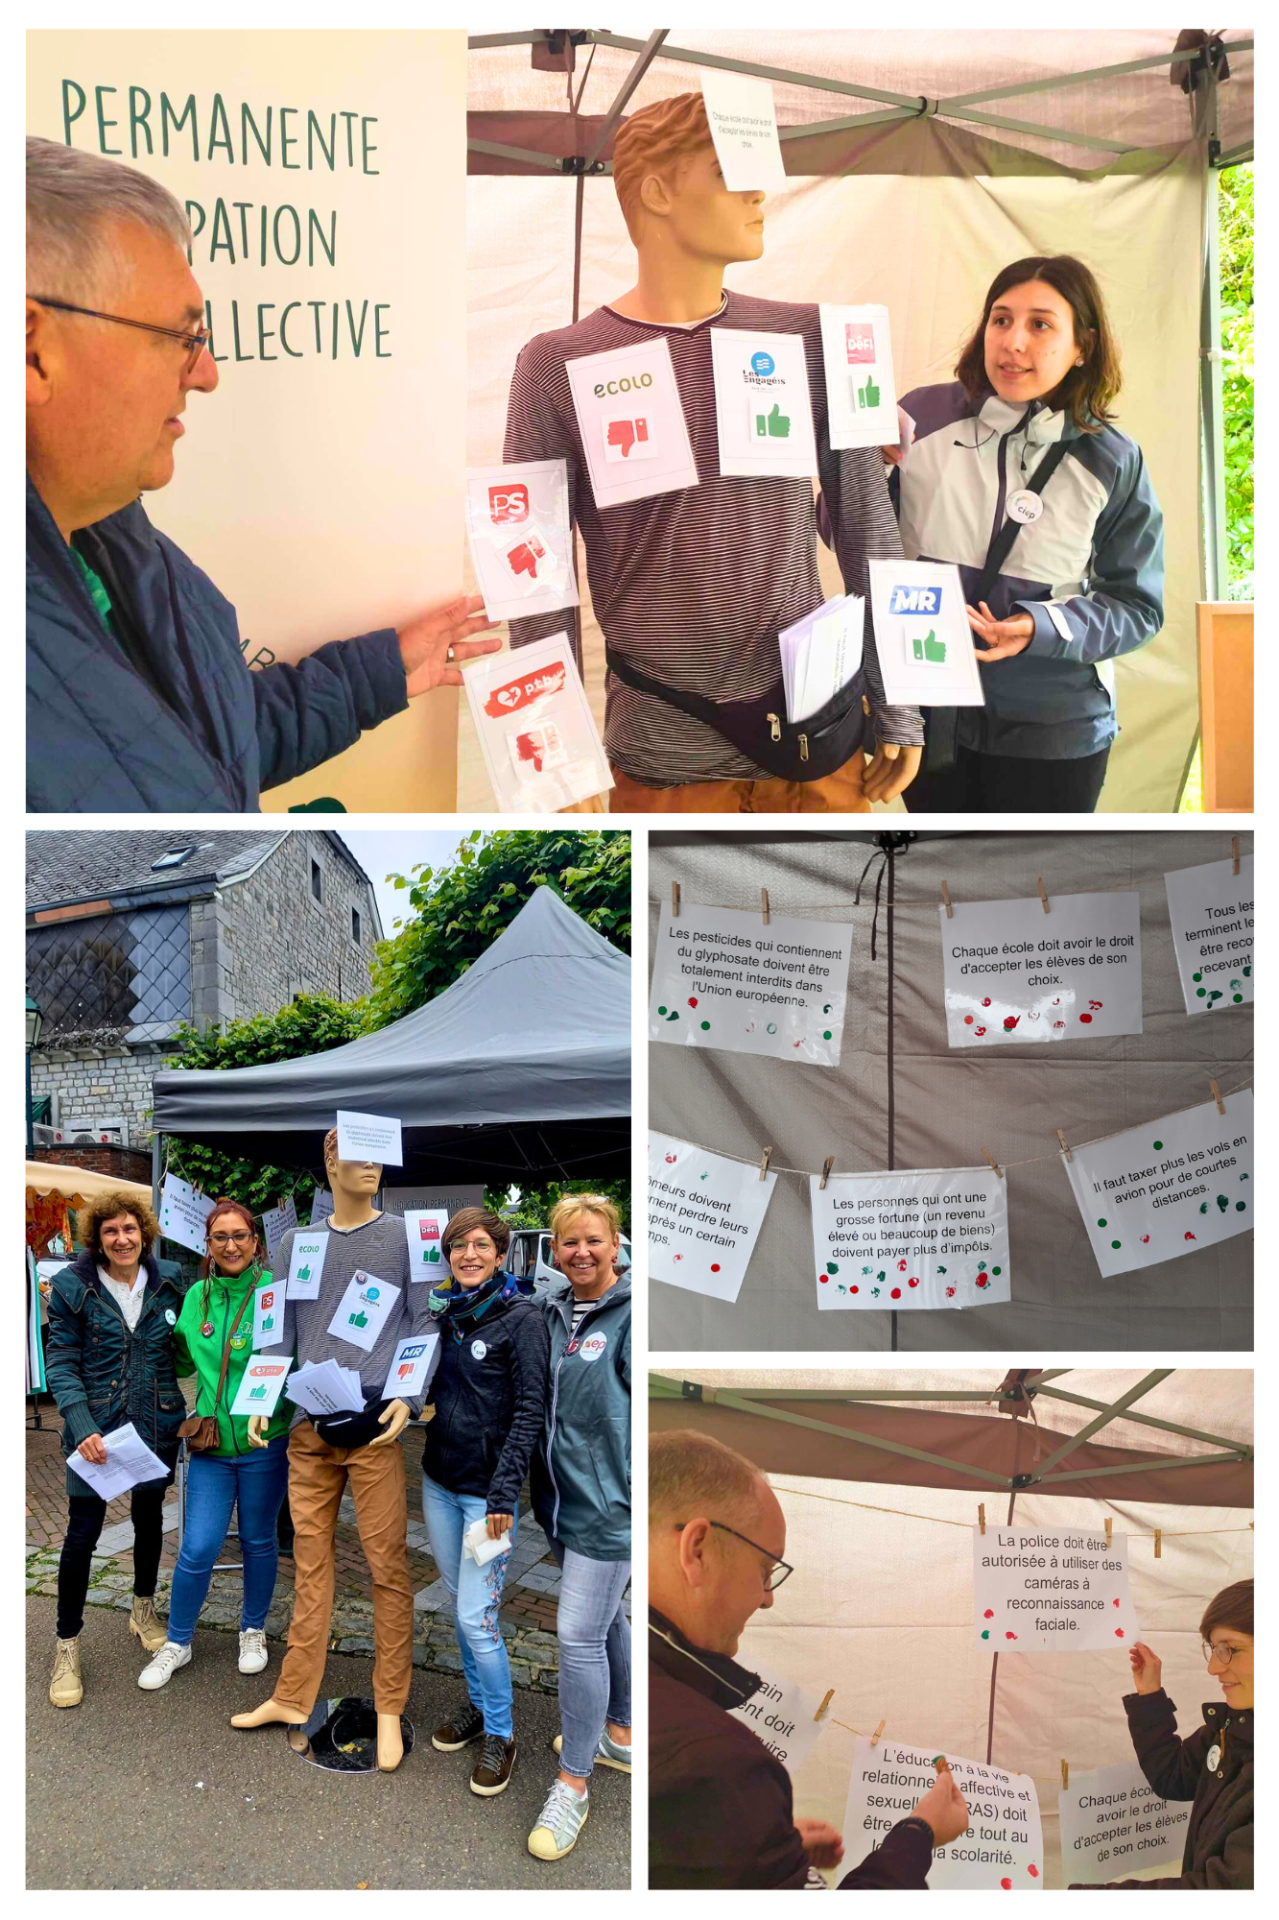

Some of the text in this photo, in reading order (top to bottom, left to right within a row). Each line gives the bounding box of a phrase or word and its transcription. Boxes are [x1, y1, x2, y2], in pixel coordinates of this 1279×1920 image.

[61, 79, 380, 175] PERMANENTE
[848, 335, 873, 350] DéFI
[594, 373, 653, 398] ecolo
[494, 492, 525, 517] PS
[894, 590, 936, 611] MR
[524, 676, 552, 696] ptb
[1205, 905, 1236, 919] Tous
[1185, 919, 1242, 941] terminent
[669, 927, 842, 960] Les pesticides qui contiennent
[952, 935, 1134, 958] Chaque école doit avoir le droit
[1200, 936, 1254, 956] être reco
[678, 946, 830, 977] du glyphosate doivent être
[961, 953, 1127, 974] d'accepter les élèves de son
[1199, 954, 1252, 975] recevant
[681, 964, 823, 992] totalement interdits dans
[1028, 974, 1063, 986] choix.
[692, 981, 808, 1008] l'Union européenne.
[1093, 1135, 1247, 1193] Il faut taxer plus les vols en
[1115, 1156, 1237, 1204] avion pour de courtes
[688, 1192, 731, 1213] doivent
[833, 1193, 987, 1211] Les personnes qui ont une
[1152, 1183, 1210, 1209] distances.
[647, 1195, 749, 1235] ment perdre leurs
[836, 1210, 985, 1227] grosse fortune (un revenu
[678, 1224, 693, 1236] un
[696, 1230, 736, 1249] certain
[828, 1223, 995, 1242] élevé ou beaucoup de biens)
[833, 1245, 874, 1258] doivent
[877, 1246, 910, 1259] payer
[913, 1244, 937, 1257] plus
[402, 1347, 422, 1358] MR
[998, 1534, 1107, 1551] La police doit être
[982, 1555, 1122, 1571] autorisée à utiliser des
[1024, 1577, 1090, 1590] caméras à
[1007, 1597, 1105, 1609] reconnaissance
[1035, 1618, 1080, 1631] faciale.
[758, 1682, 783, 1702] ain
[764, 1714, 796, 1737] doit
[967, 1765, 975, 1775] à
[978, 1767, 989, 1778] la
[992, 1772, 1009, 1783] vie
[862, 1770, 1031, 1801] relationne affective et
[1079, 1790, 1127, 1808] Chaque
[1003, 1807, 1027, 1821] doit
[1096, 1799, 1168, 1823] avoir le droit
[863, 1815, 892, 1831] être
[980, 1827, 1007, 1842] tout
[1011, 1831, 1028, 1843] au
[1074, 1810, 1188, 1850] d'accepter les élèves
[933, 1847, 1016, 1865] la scolarité.
[1097, 1835, 1169, 1862] de son choix.
